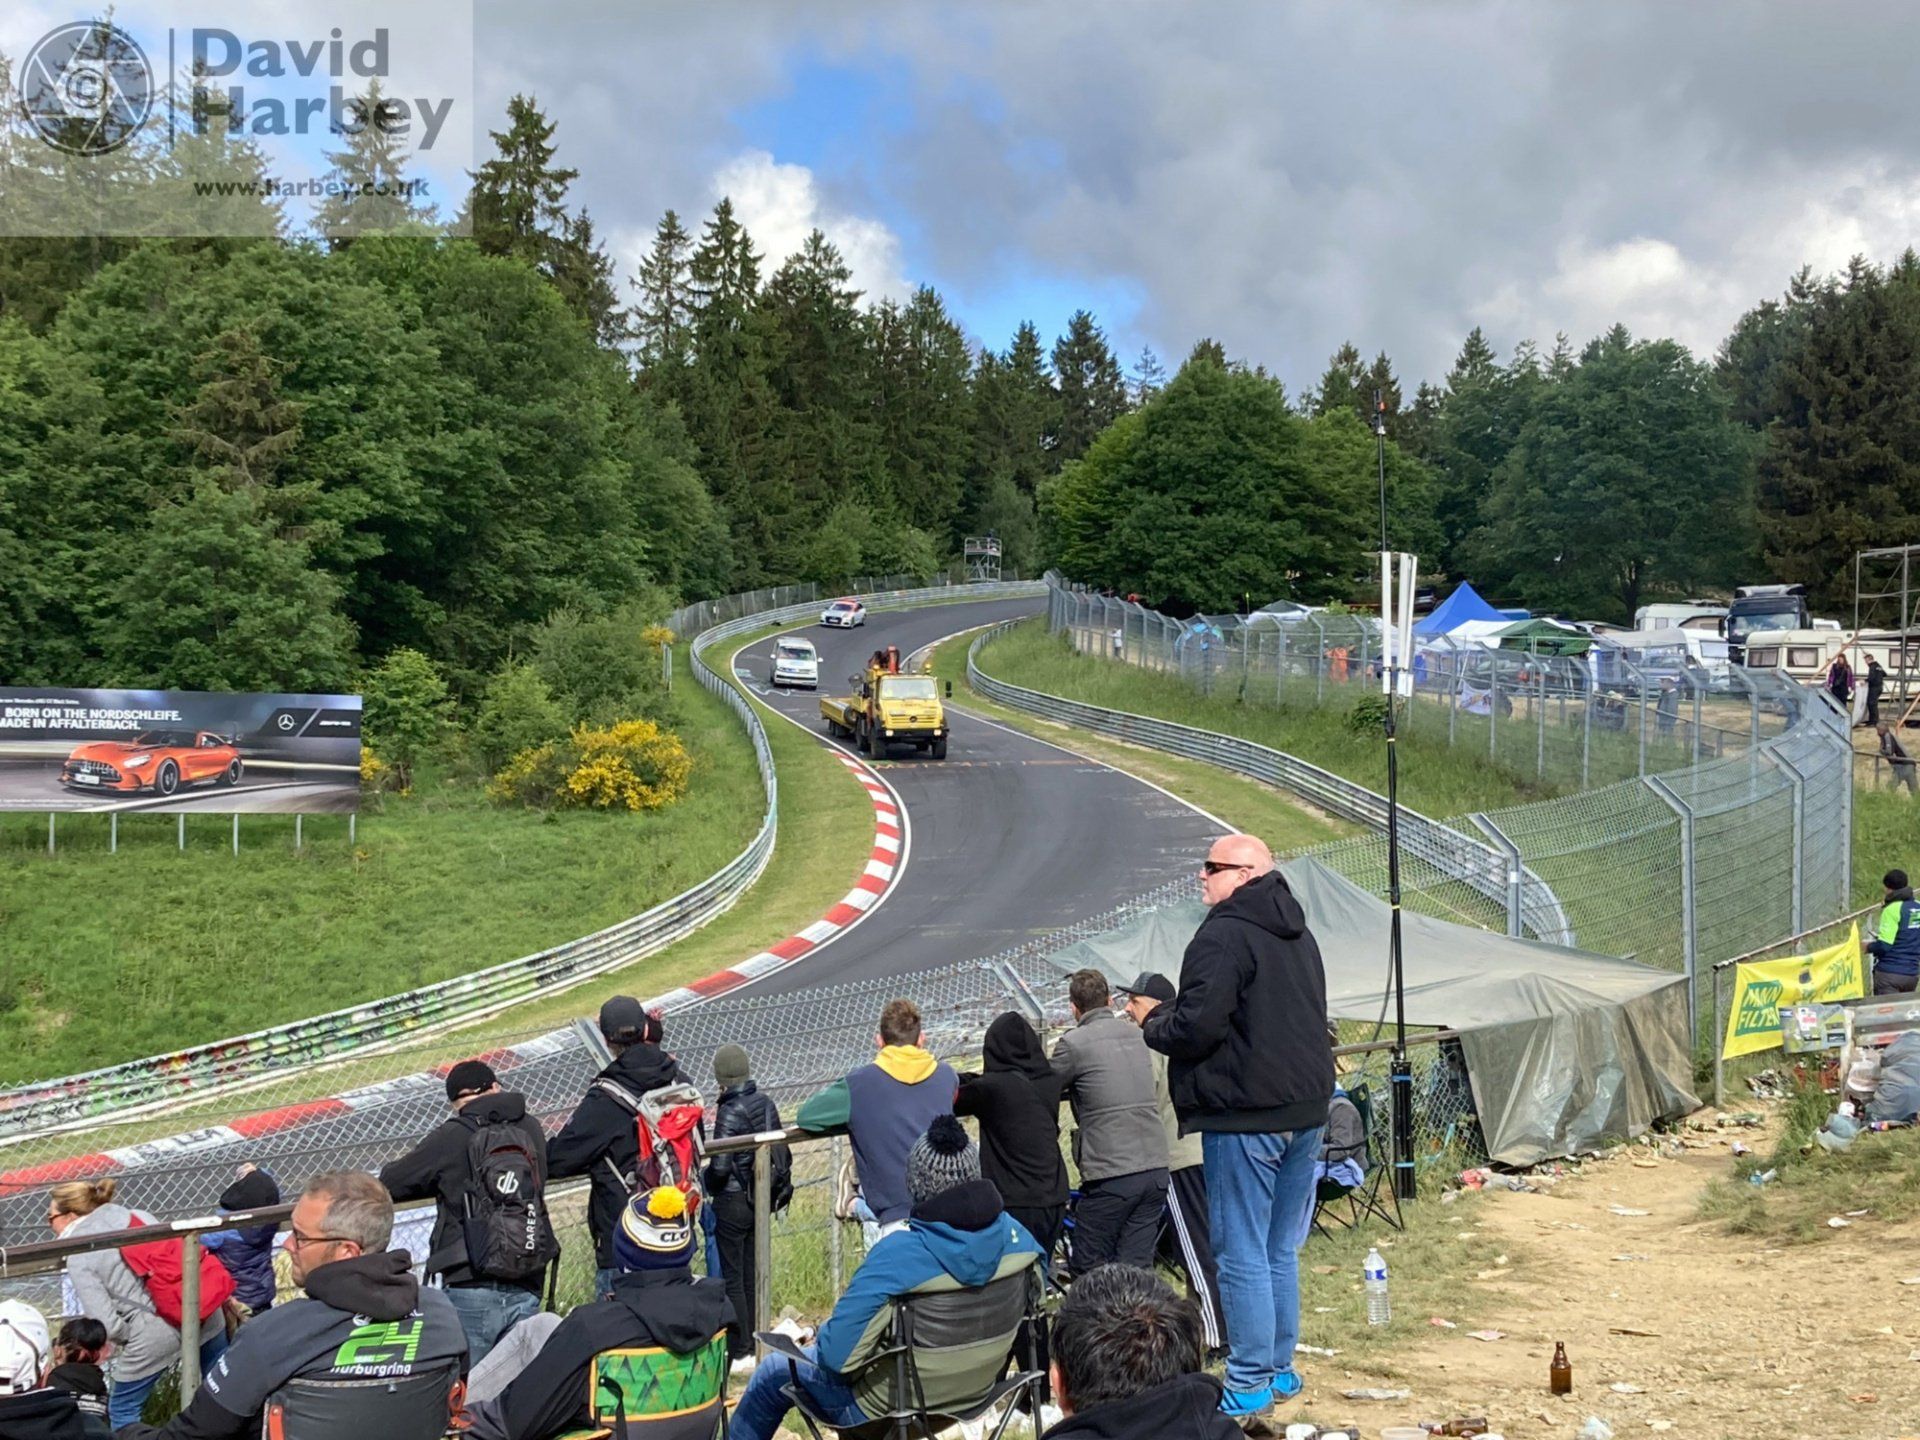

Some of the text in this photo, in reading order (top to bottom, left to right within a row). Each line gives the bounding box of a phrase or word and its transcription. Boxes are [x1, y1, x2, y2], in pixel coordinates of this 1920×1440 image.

[5, 707, 182, 721] BORN ON THE NORDSCHLEIFE.
[0, 717, 141, 730] MADE IN AFFALTERBACH.
